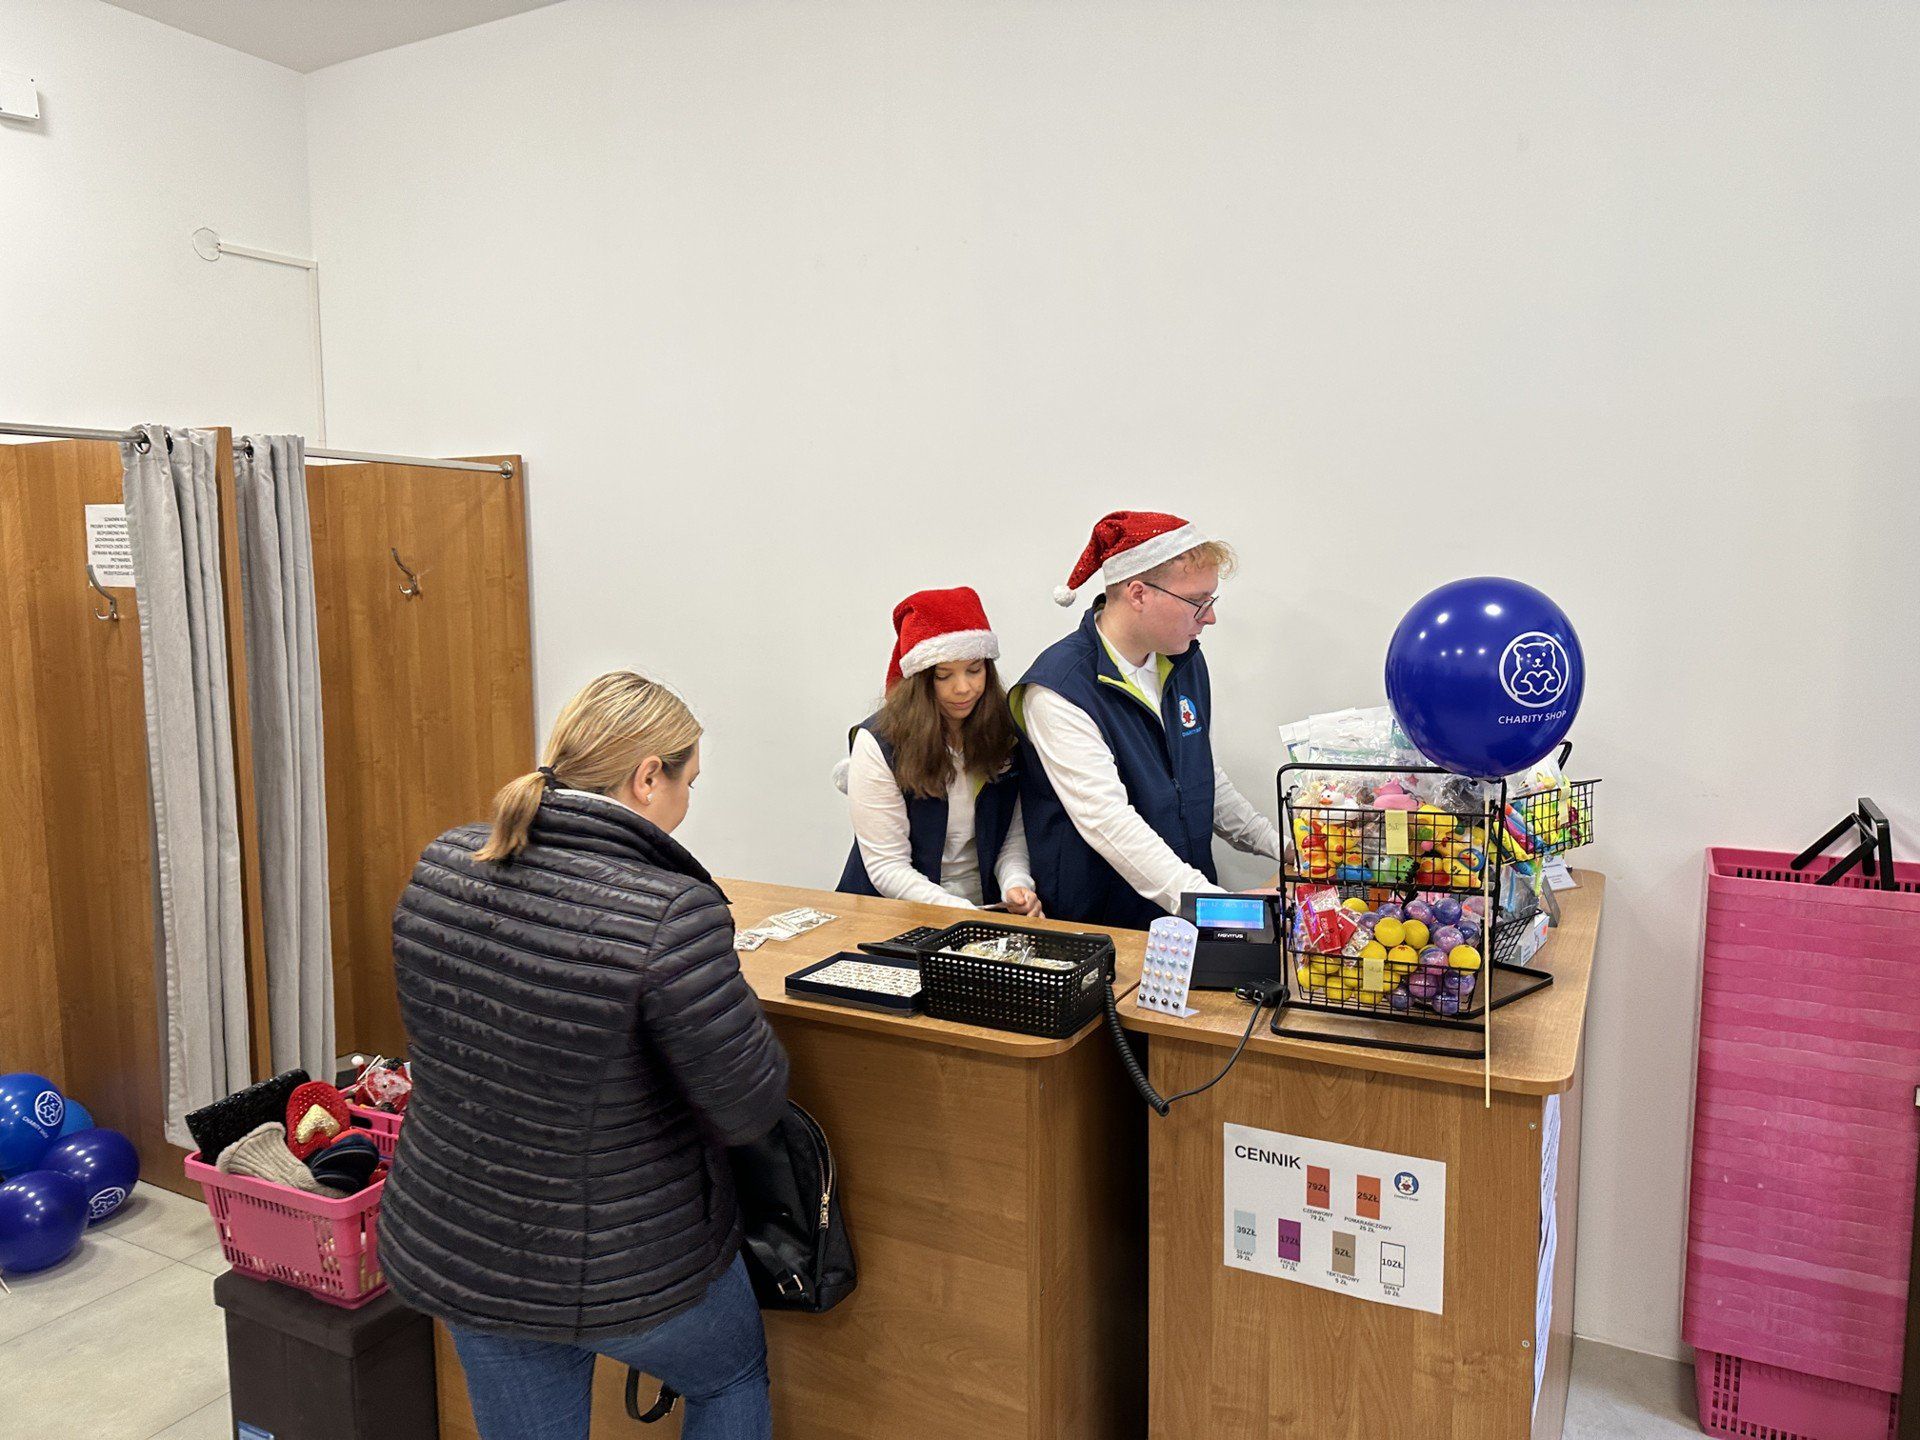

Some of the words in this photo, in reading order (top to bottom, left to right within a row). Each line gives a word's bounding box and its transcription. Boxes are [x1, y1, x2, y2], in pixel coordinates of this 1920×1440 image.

[1498, 714, 1543, 724] CHARITY
[1545, 710, 1567, 721] SHOP
[1235, 1145, 1301, 1170] CENNIK
[1308, 1182, 1329, 1193] 79ZŁ
[1357, 1192, 1379, 1203] 25ZŁ
[1236, 1225, 1257, 1237] 39ZŁ
[1280, 1235, 1300, 1246] 17ZŁ
[1334, 1247, 1352, 1258] 5ZŁ
[1382, 1258, 1404, 1269] 10ZŁ
